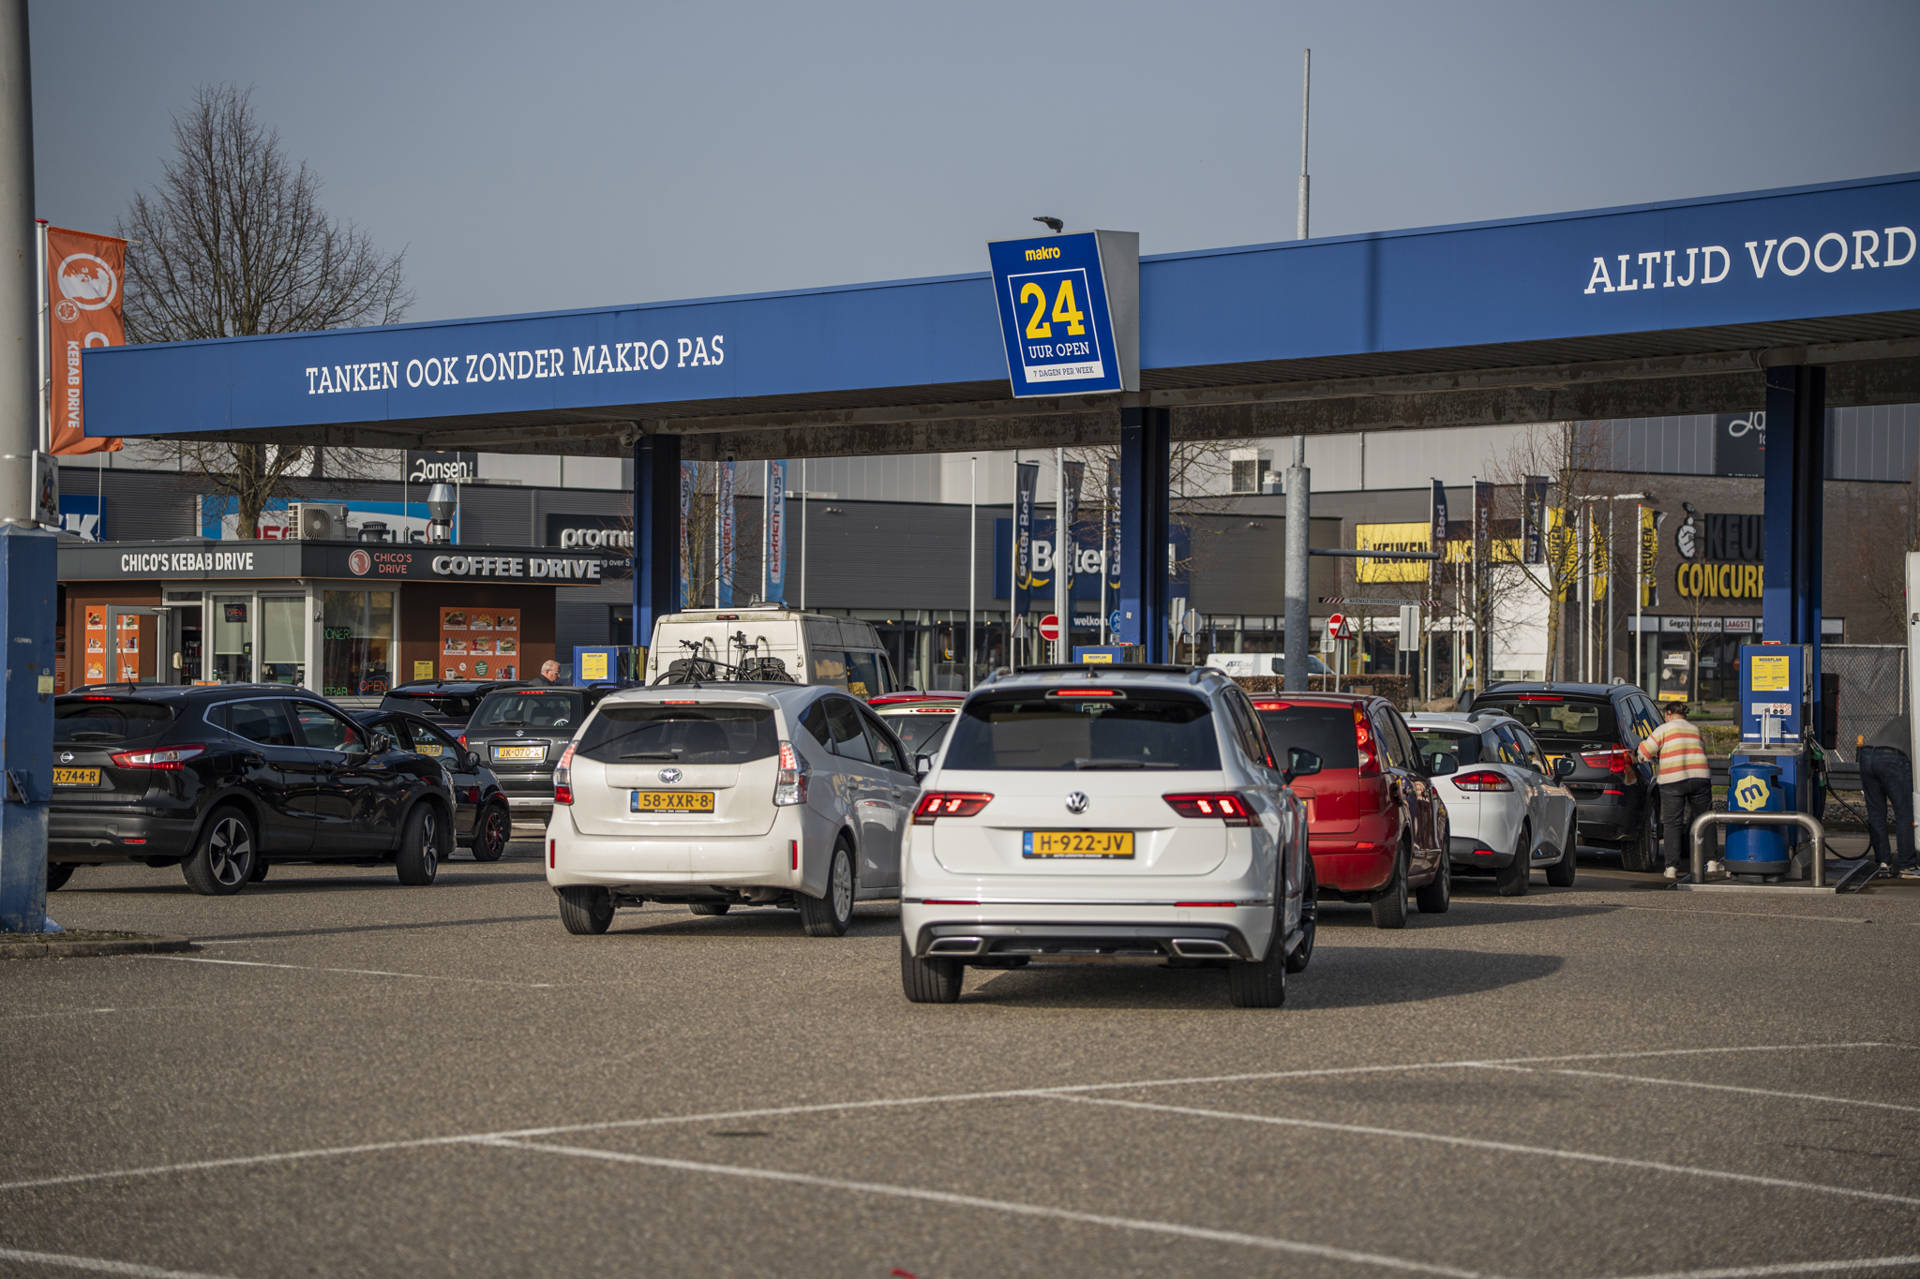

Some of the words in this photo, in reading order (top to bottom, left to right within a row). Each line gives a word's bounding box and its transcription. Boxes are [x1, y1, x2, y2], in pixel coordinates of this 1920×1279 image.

[1024, 246, 1061, 262] makro
[1583, 245, 1731, 295] ALTIJD
[1744, 226, 1917, 279] VOORD
[1020, 279, 1086, 340] 24
[1028, 345, 1054, 360] UUR
[1055, 341, 1090, 357] OPEN
[67, 341, 80, 386] KEBAB
[305, 361, 399, 395] TANKEN
[405, 356, 459, 389] OOK
[465, 348, 565, 383] ZONDER
[572, 339, 669, 376] MAKRO
[677, 334, 725, 368] PAS
[1033, 370, 1038, 378] 7
[1039, 368, 1061, 378] DAGEN
[1063, 367, 1074, 376] PER
[1075, 366, 1095, 375] WEEK
[67, 388, 80, 429] DRIVE
[410, 458, 467, 482] Jansen
[1018, 490, 1031, 526] Bed
[121, 553, 169, 573] CHICO'S
[171, 552, 213, 571] KEBAB
[215, 551, 254, 571] DRIVE
[373, 552, 413, 565] CHICO'S
[378, 563, 408, 575] DRIVE
[432, 555, 523, 577] COFFEE
[529, 558, 601, 580] DRIVE
[643, 794, 709, 808] 58-XXR-8
[1040, 835, 1125, 851] H-922-JV
